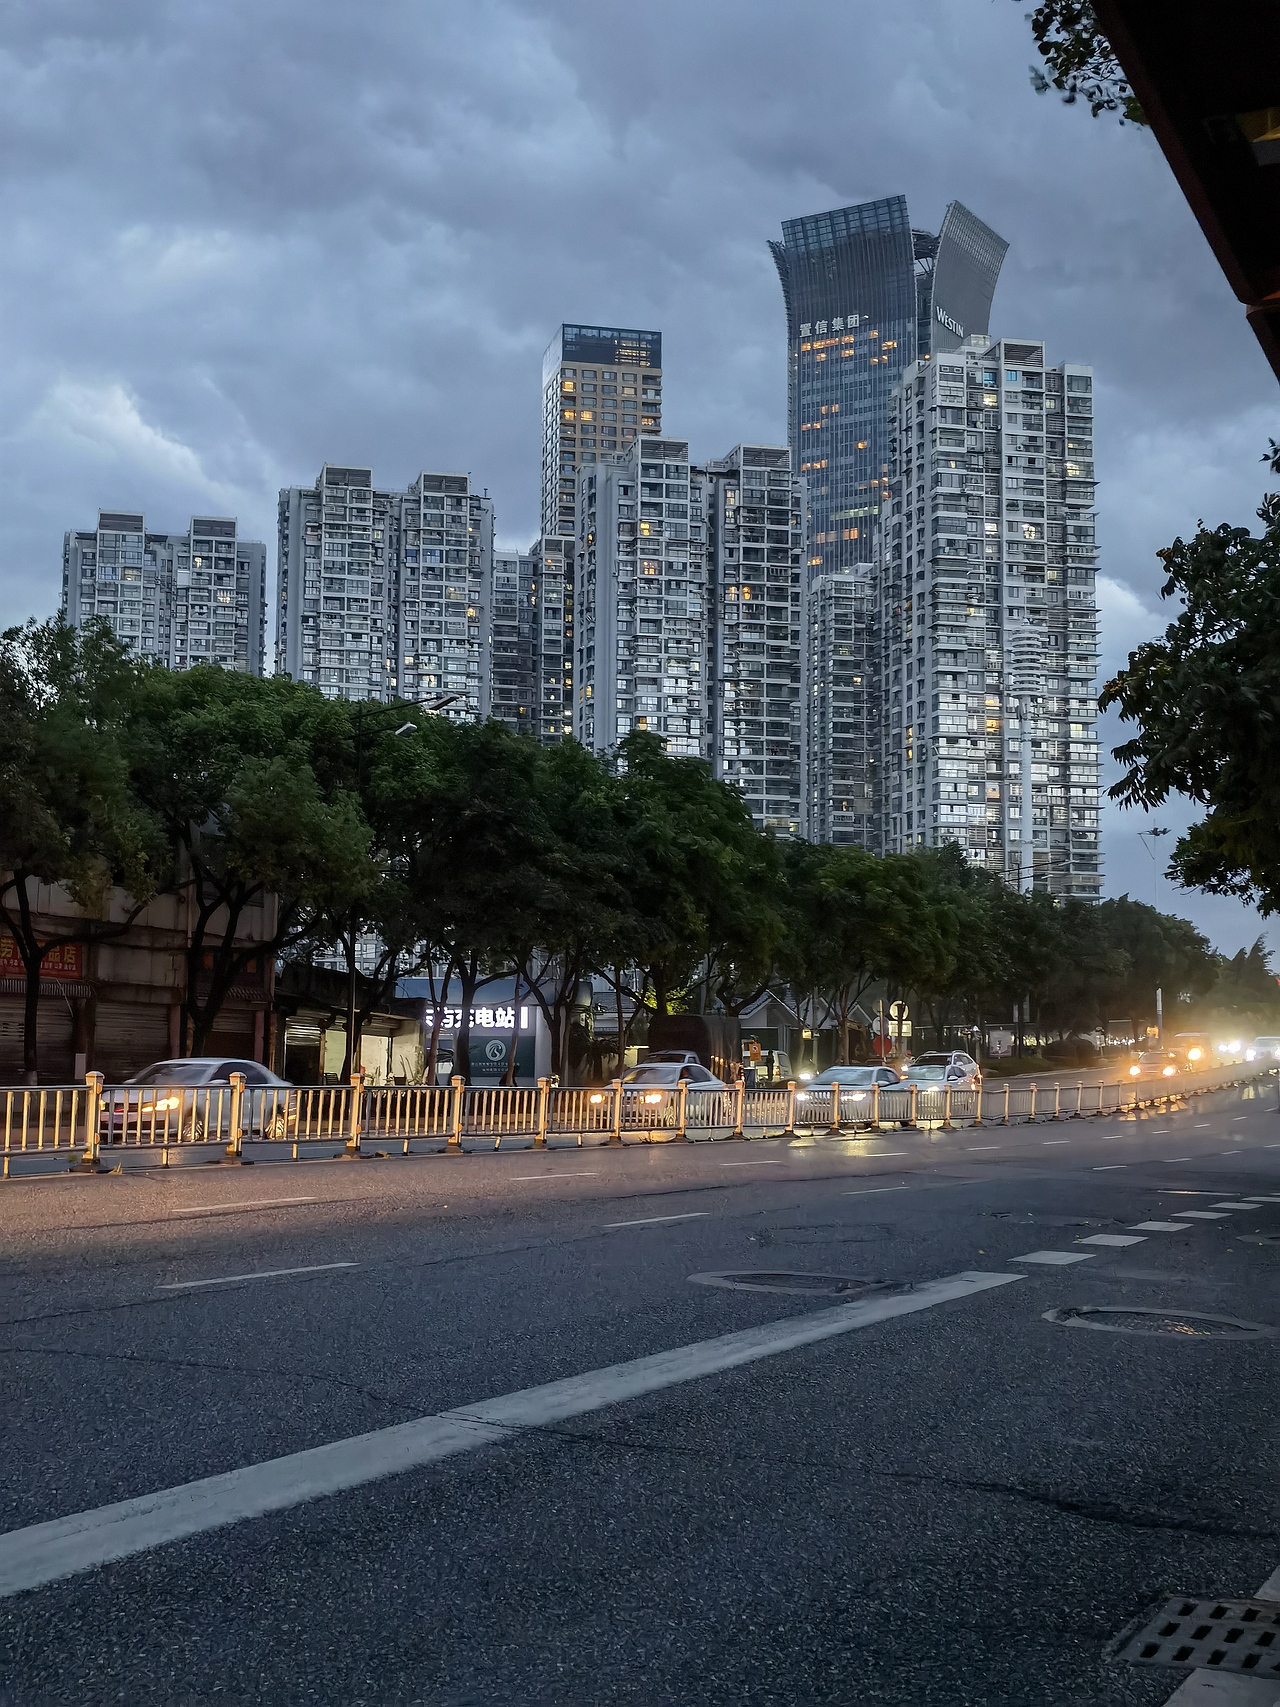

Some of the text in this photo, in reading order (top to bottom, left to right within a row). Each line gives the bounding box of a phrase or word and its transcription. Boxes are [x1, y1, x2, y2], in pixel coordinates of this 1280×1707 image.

[799, 314, 860, 338] 置信集团
[936, 305, 965, 338] WESTIN
[0, 938, 77, 964] 劳品店
